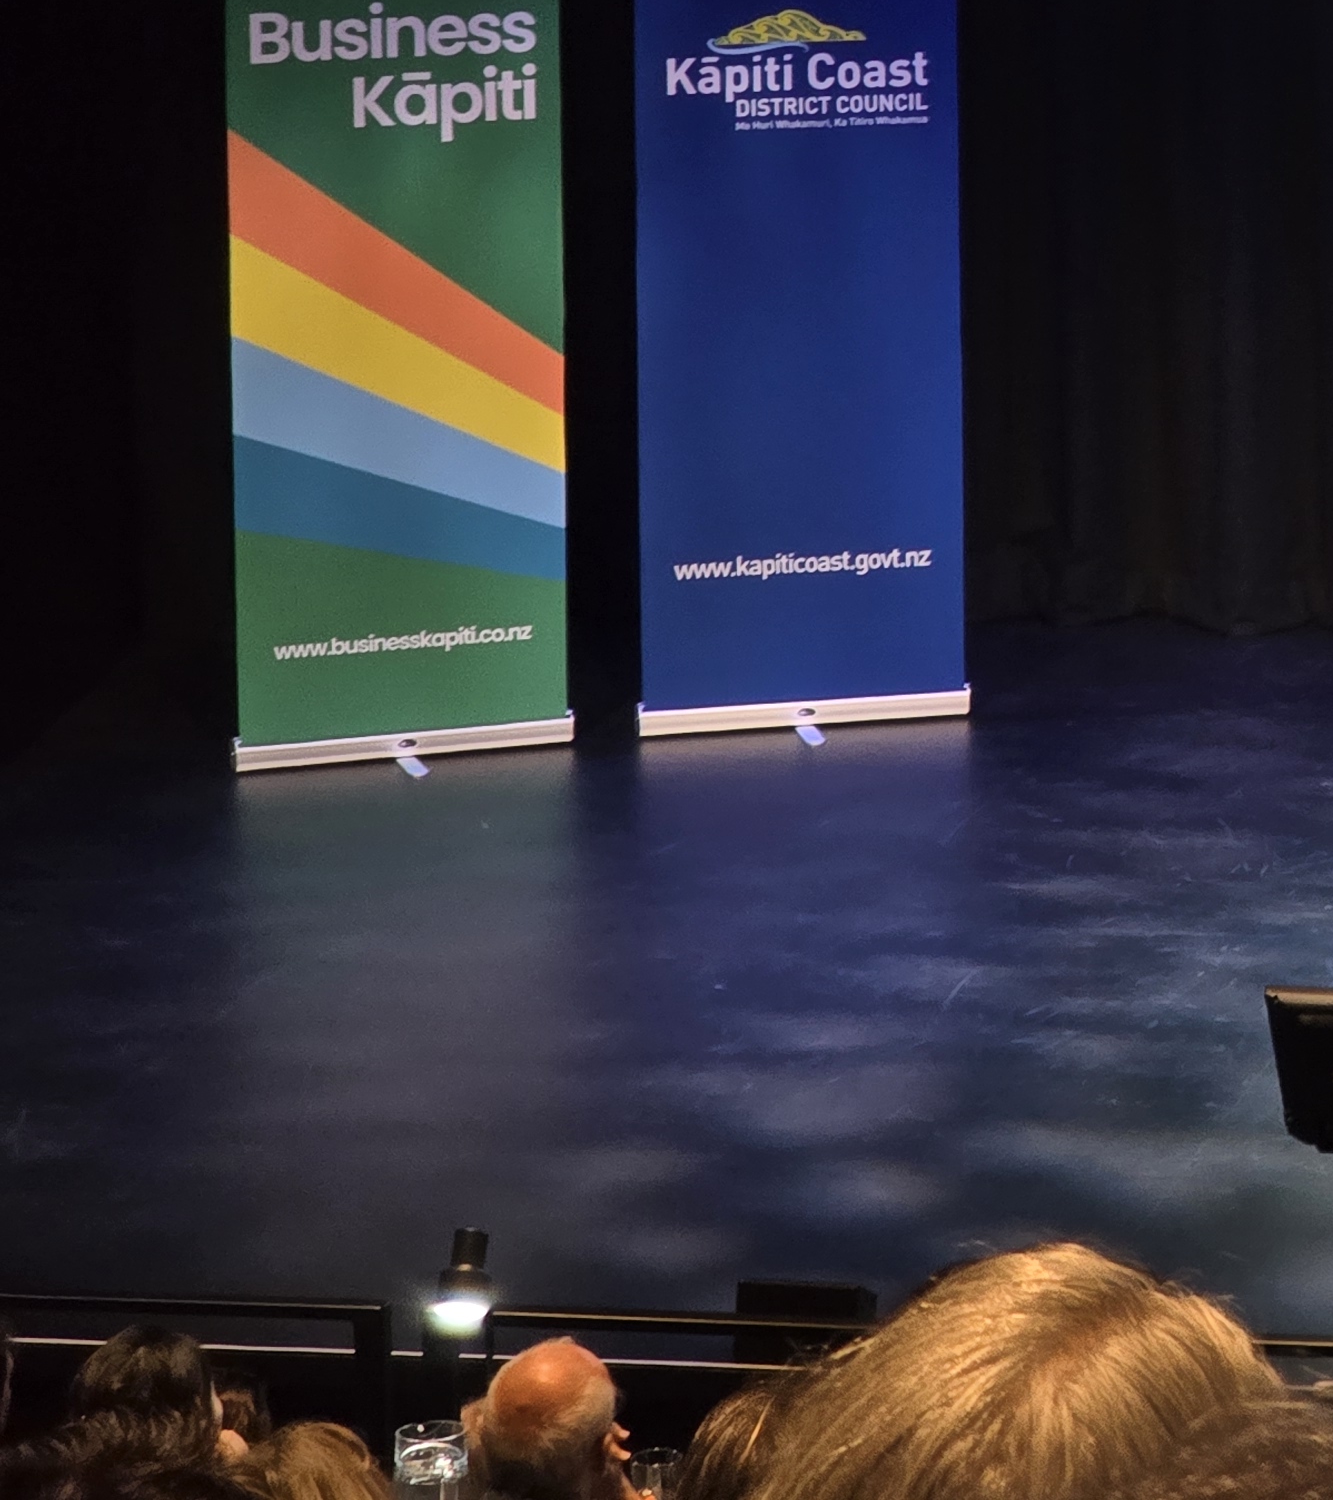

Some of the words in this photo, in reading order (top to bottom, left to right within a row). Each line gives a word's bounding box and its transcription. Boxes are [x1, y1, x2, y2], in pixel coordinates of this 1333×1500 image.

[250, 2, 537, 65] Business
[666, 52, 793, 103] Kāpiti
[807, 51, 929, 91] Coast
[353, 63, 538, 143] Kāpiti
[735, 96, 832, 117] DISTRICT
[836, 93, 929, 114] COUNCIL
[673, 548, 932, 581] www.kapiticoast.govt.nz
[273, 624, 533, 660] www.businesskapiti.co.nz
